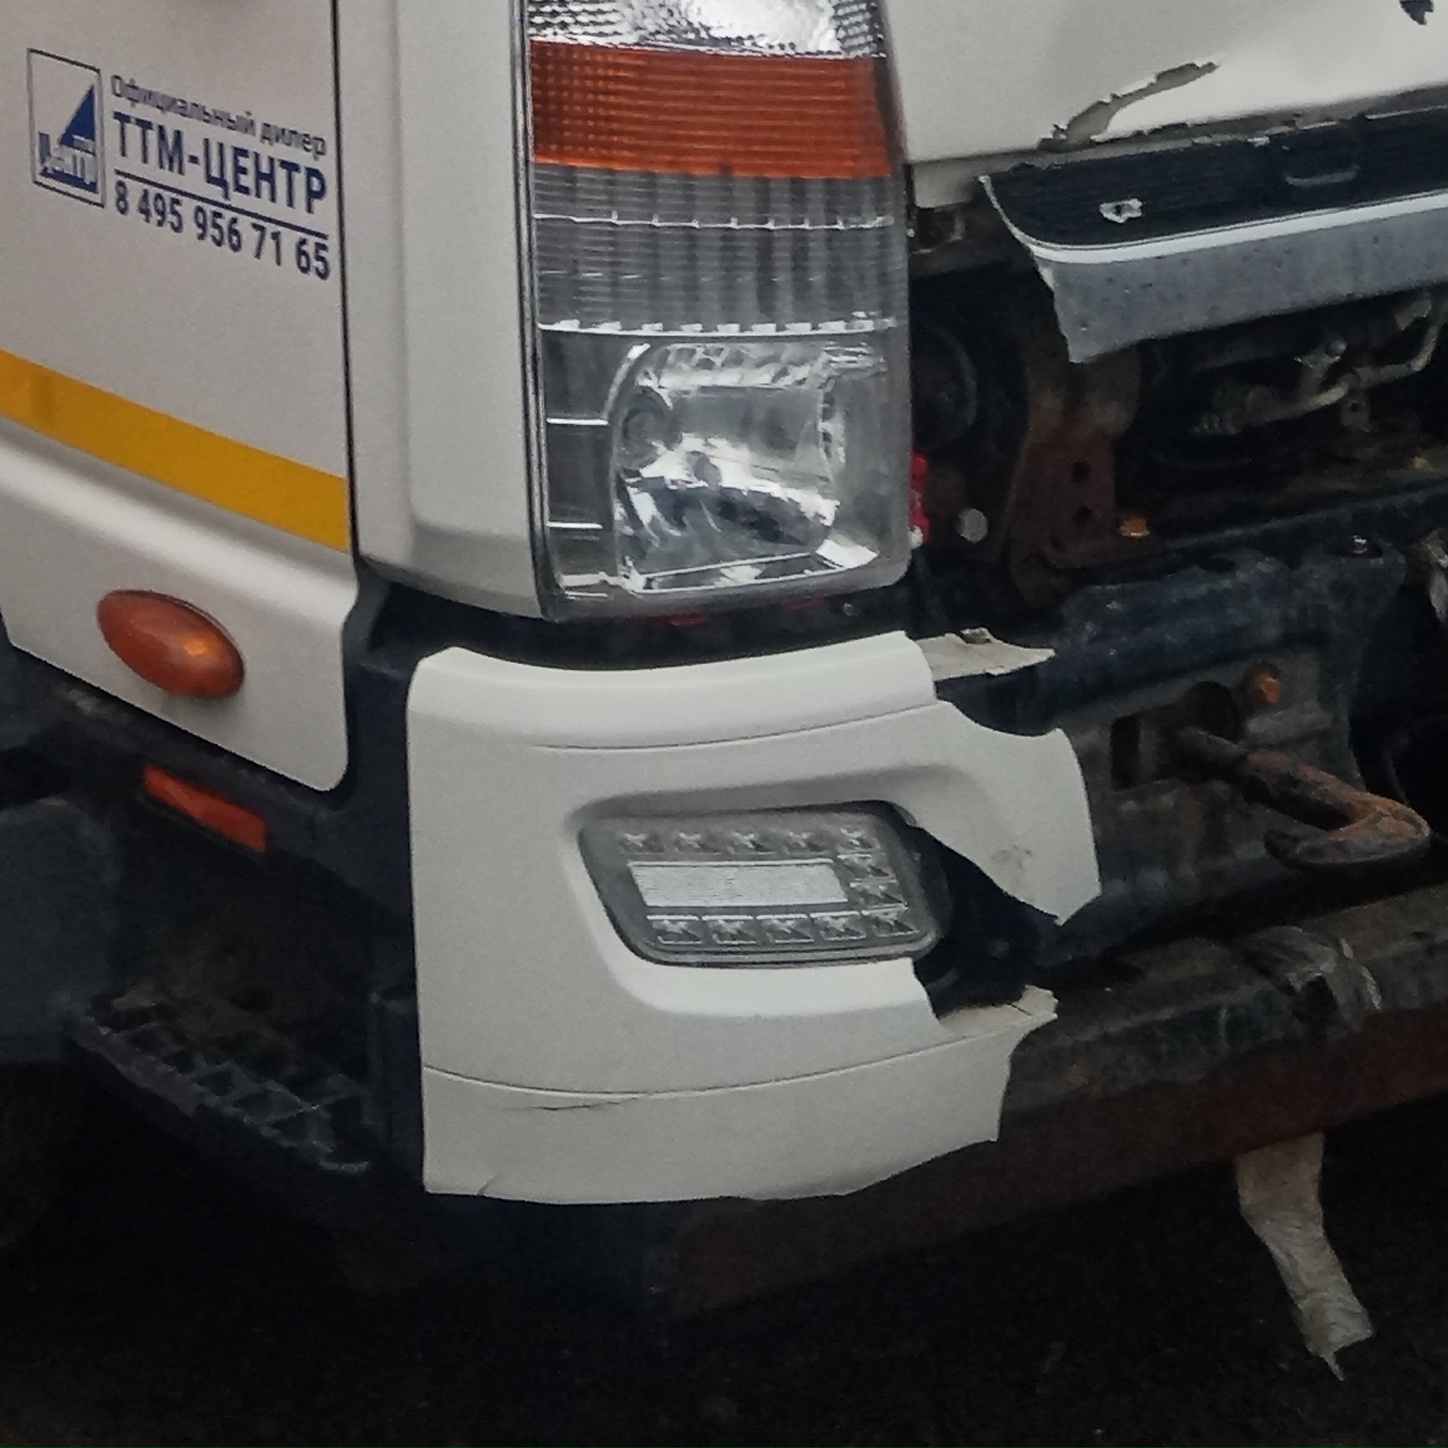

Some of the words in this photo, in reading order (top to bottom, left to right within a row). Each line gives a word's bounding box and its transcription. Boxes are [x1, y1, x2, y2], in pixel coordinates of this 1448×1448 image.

[113, 110, 327, 214] ТТМ-ЦЕНТР
[260, 122, 327, 161] дилер
[114, 179, 129, 216] 8
[138, 188, 183, 234] 495
[194, 205, 242, 254] 956
[250, 222, 282, 266] 71
[295, 237, 331, 281] 65
